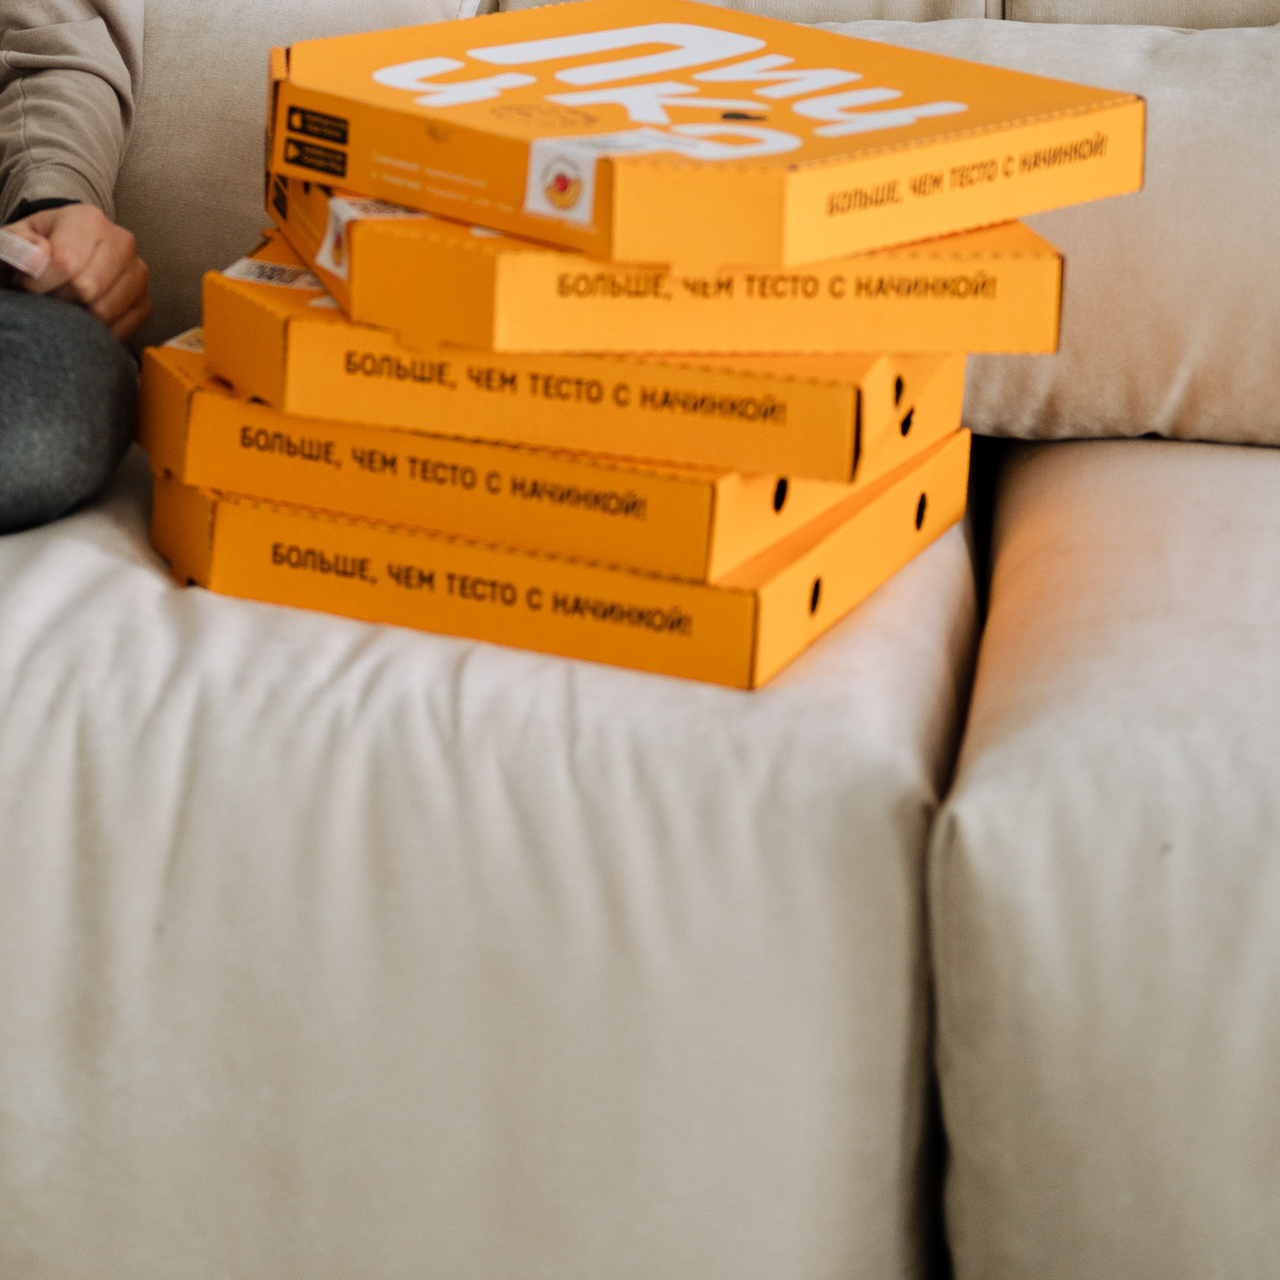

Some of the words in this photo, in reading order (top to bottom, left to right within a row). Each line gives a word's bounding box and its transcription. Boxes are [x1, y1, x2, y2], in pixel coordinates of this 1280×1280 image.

[826, 179, 902, 217] БОЛЬШЕ,
[909, 172, 944, 197] ЧЕМ
[949, 159, 999, 189] ТЕСТО
[1001, 155, 1015, 178] С
[557, 272, 673, 301] БОЛЬШЕ,
[682, 276, 734, 299] ЧЕМ
[745, 274, 819, 299] ТЕСТО
[828, 274, 845, 299] С
[854, 269, 997, 300] НАЧИНКОЙ!
[344, 351, 457, 391] БОЛЬШЕ,
[466, 365, 518, 394] ЧЕМ
[529, 372, 603, 404] ТЕСТО
[612, 383, 631, 408] С
[640, 385, 787, 427] НАЧИНКОЙ!
[239, 425, 342, 470] БОЛЬШЕ,
[351, 446, 397, 476] ЧЕМ
[408, 456, 477, 490] ТЕСТО
[485, 470, 502, 495] С
[511, 480, 647, 521] НАЧИНКОЙ!
[271, 542, 378, 586] БОЛЬШЕ,
[387, 562, 435, 593] ЧЕМ
[445, 572, 517, 606] ТЕСТО
[525, 587, 543, 612] С
[552, 593, 693, 637] НАЧИНКОЙ!
